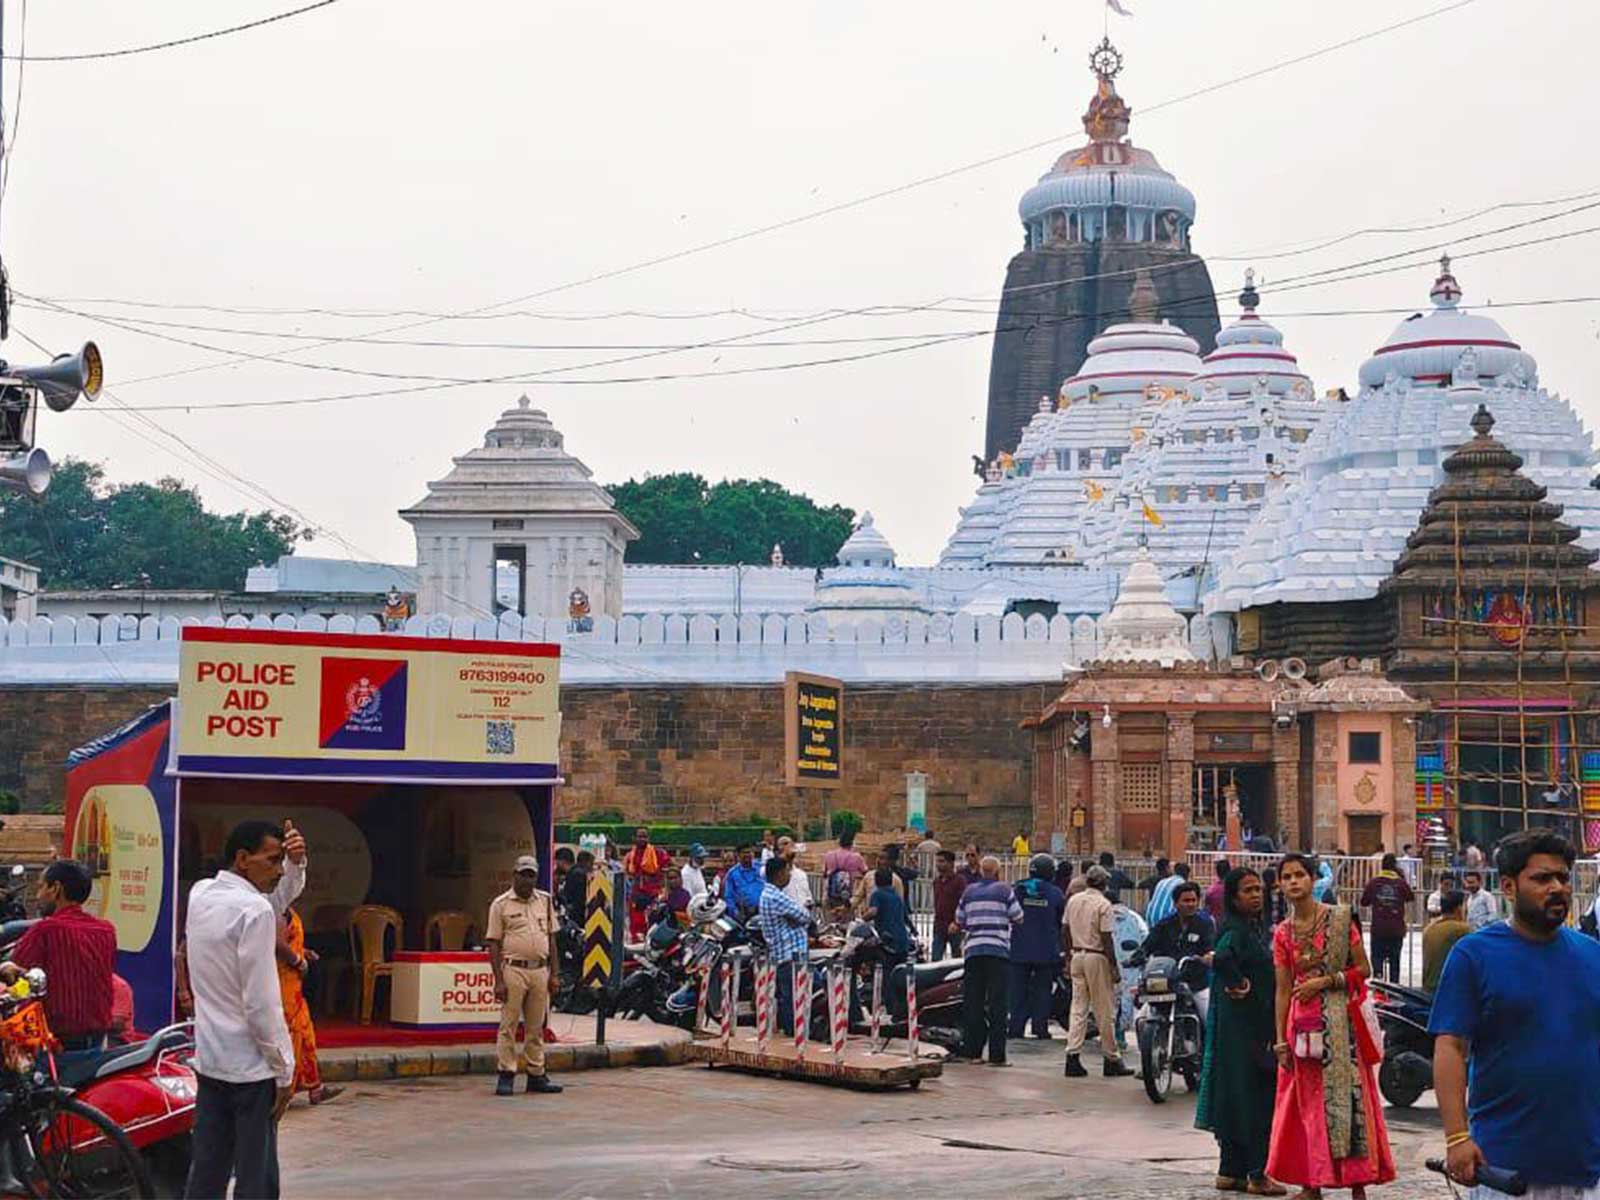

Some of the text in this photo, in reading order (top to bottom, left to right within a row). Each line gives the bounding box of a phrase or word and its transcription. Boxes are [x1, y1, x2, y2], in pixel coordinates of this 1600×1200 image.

[197, 661, 296, 685] POLICE
[459, 670, 545, 684] 8763199400
[223, 689, 269, 710] AID
[493, 696, 511, 708] 112
[208, 715, 283, 737] POST
[454, 973, 493, 987] PURI
